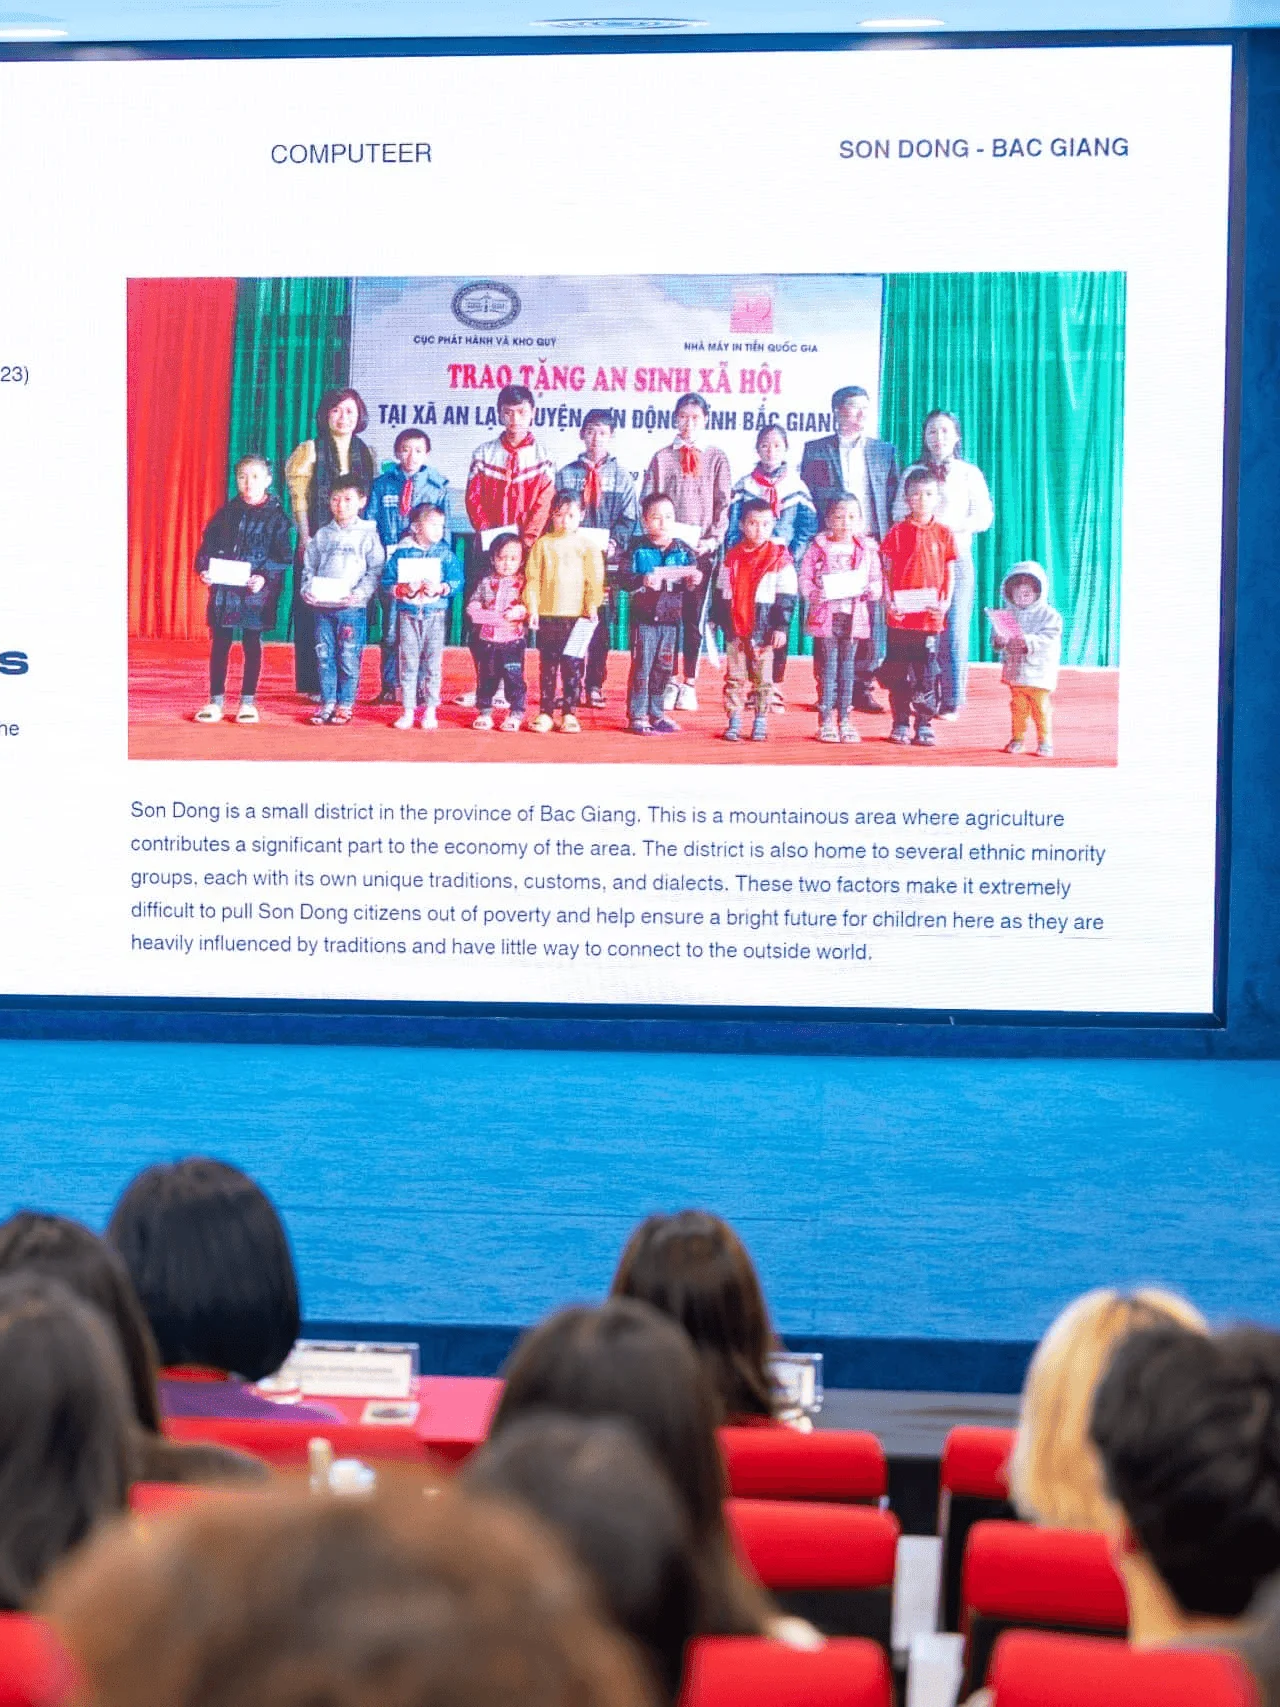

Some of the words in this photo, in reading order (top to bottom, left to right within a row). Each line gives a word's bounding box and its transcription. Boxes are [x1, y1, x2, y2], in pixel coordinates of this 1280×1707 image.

[271, 142, 432, 165] COMPUTEER
[839, 139, 890, 160] SON
[898, 138, 969, 159] DONG
[992, 137, 1042, 159] BAC
[1050, 136, 1129, 158] GIANG
[512, 336, 535, 347] KHO
[732, 342, 743, 353] IN
[800, 344, 819, 354] GIA
[446, 363, 514, 390] TRAO
[591, 366, 628, 393] AN
[633, 367, 691, 394] SINH
[697, 361, 732, 395] XÃ
[739, 361, 783, 403] HỘI
[377, 404, 406, 429] TẠI
[412, 401, 438, 425] XÃ
[442, 405, 470, 426] AN
[529, 403, 582, 432] UYỆN
[131, 800, 166, 819] Son
[172, 800, 220, 823] Dong
[226, 801, 240, 819] is
[245, 806, 256, 819] a
[261, 802, 309, 820] small
[314, 802, 374, 821] district
[379, 803, 394, 821] in
[399, 803, 428, 821] the
[433, 804, 512, 825] province
[517, 805, 535, 822] of
[540, 804, 575, 822] Bac
[581, 804, 641, 827] Giang.
[647, 805, 687, 823] This
[692, 806, 707, 824] is
[712, 810, 724, 824] a
[729, 807, 849, 825] mountainous
[855, 811, 897, 825] area
[902, 807, 960, 826] where
[965, 808, 1065, 831] agriculture
[130, 834, 231, 853] contributes
[235, 839, 246, 853] a
[252, 835, 342, 857] significant
[348, 837, 383, 858] part
[388, 837, 405, 855] to
[410, 837, 439, 855] the
[444, 841, 528, 860] economy
[533, 838, 551, 856] of
[555, 839, 585, 856] the
[590, 843, 636, 857] area.
[642, 839, 678, 857] The
[683, 840, 744, 858] district
[750, 840, 765, 858] is
[770, 841, 809, 859] also
[814, 840, 867, 859] home
[871, 842, 890, 859] to
[895, 842, 963, 861] several
[968, 842, 1026, 862] ethnic
[1031, 843, 1106, 867] minority
[131, 871, 198, 889] groups,
[203, 868, 247, 886] each
[253, 869, 289, 886] with
[294, 869, 314, 887] its
[319, 873, 357, 887] own
[363, 870, 424, 892] unique
[428, 871, 518, 890] traditions,
[524, 873, 606, 893] customs,
[612, 873, 647, 891] and
[652, 873, 729, 892] dialects.
[735, 873, 793, 893] These
[798, 876, 831, 894] two
[836, 875, 900, 894] factors
[906, 875, 958, 895] make
[963, 876, 974, 895] it
[978, 877, 1071, 900] extremely
[131, 900, 195, 919] difficult
[199, 903, 216, 919] to
[221, 902, 253, 923] pull
[258, 901, 294, 920] Son
[300, 902, 348, 925] Dong
[353, 903, 422, 921] citizens
[427, 905, 456, 922] out
[461, 904, 478, 922] of
[483, 906, 551, 928] poverty
[556, 906, 590, 924] and
[596, 906, 635, 929] help
[641, 911, 704, 925] ensure
[709, 911, 721, 926] a
[727, 908, 779, 930] bright
[783, 908, 838, 928] future
[842, 908, 868, 928] for
[872, 910, 947, 929] children
[953, 911, 995, 929] here
[1000, 915, 1023, 929] as
[1027, 911, 1069, 935] they
[1073, 916, 1104, 931] are
[131, 933, 194, 956] heavily
[199, 934, 291, 953] influenced
[297, 935, 318, 957] by
[323, 936, 407, 954] traditions
[412, 937, 446, 955] and
[452, 937, 496, 956] have
[501, 938, 537, 956] little
[543, 943, 580, 961] way
[584, 940, 602, 957] to
[607, 941, 681, 958] connect
[686, 941, 703, 958] to
[708, 941, 738, 959] the
[743, 941, 811, 960] outside
[816, 943, 872, 961] world.
